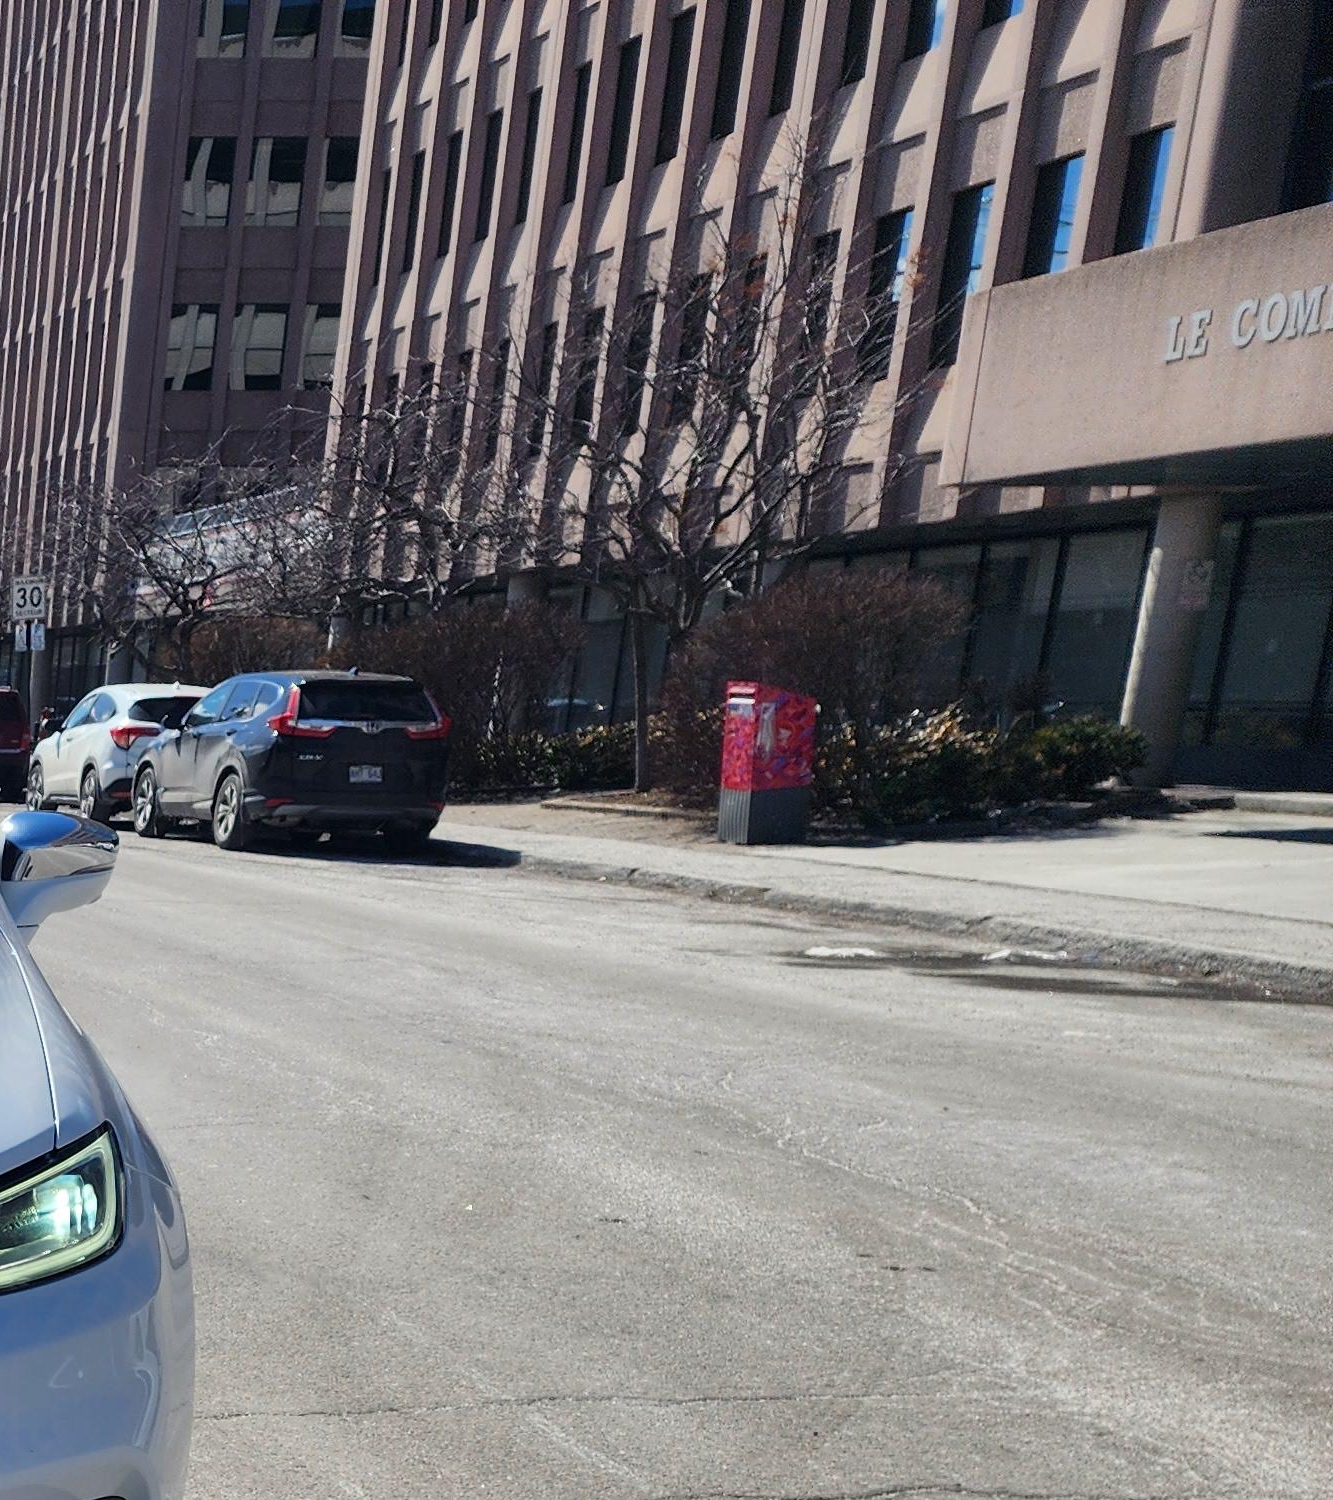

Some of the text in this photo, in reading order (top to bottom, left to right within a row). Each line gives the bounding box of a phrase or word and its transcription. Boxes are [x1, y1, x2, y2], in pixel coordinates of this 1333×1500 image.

[1164, 284, 1333, 365] LE COM
[16, 587, 42, 608] 30
